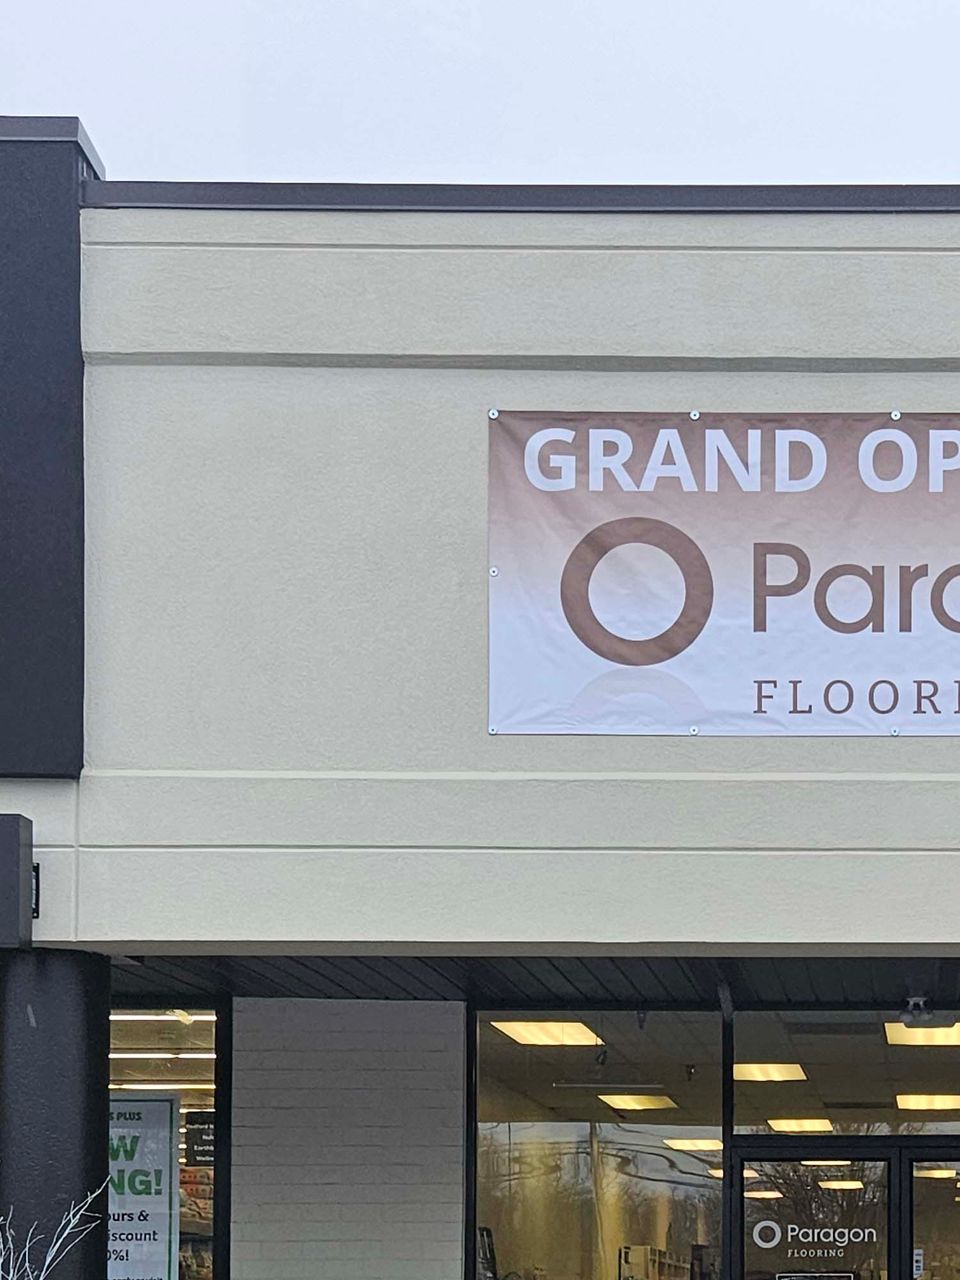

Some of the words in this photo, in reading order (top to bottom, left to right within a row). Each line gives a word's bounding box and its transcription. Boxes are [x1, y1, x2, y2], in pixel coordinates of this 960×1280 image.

[522, 427, 828, 493] GRAND
[116, 1112, 143, 1121] PLUS
[138, 1210, 150, 1222] &
[786, 1224, 878, 1247] Paragon
[786, 1249, 845, 1258] FLOORING
